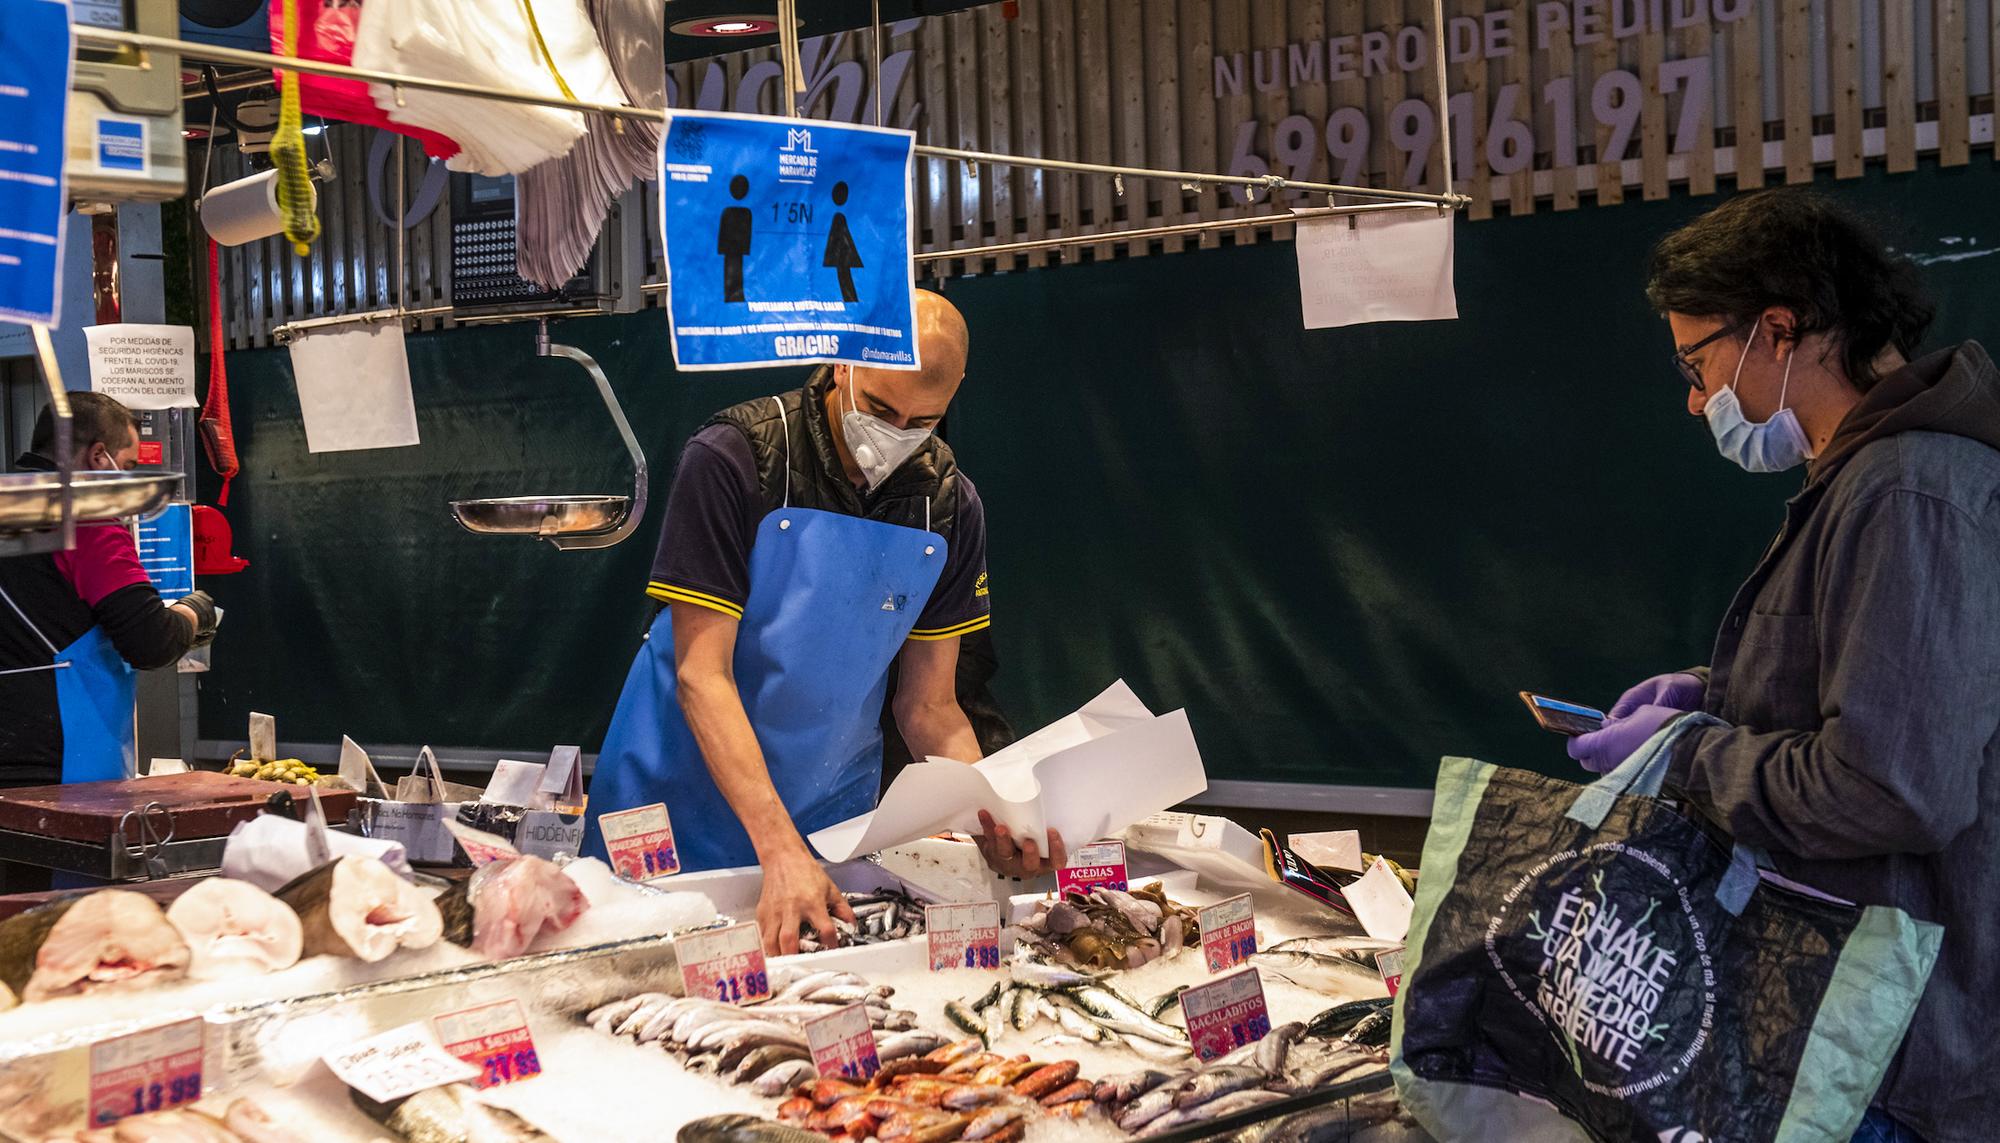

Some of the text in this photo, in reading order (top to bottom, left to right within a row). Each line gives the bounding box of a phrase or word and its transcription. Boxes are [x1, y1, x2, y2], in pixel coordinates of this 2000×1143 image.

[1214, 26, 1427, 98] NUMERO
[1450, 10, 1515, 63] DE
[779, 154, 817, 167] MERCADO DE
[779, 165, 817, 178] MARAVILLAS
[98, 347, 184, 355] SEGURIDAD HIGIÉNICAS
[774, 334, 839, 357] GRACIAS
[108, 386, 141, 394] PETICIÓN
[142, 387, 155, 395] DEL
[1190, 814, 1206, 839] G
[1283, 849, 1300, 878] PULPO
[1529, 861, 1549, 877] una
[1549, 849, 1578, 865] mano
[1593, 840, 1625, 852] medio
[1626, 846, 1671, 880] ambiente.
[1070, 867, 1114, 879] ACEDIAS
[1688, 914, 1700, 930] un
[1700, 954, 1712, 967] de
[1584, 951, 1659, 1013] MANO
[1558, 967, 1650, 1041] MEDIO
[1705, 992, 1717, 1003] al
[1190, 997, 1263, 1031] BACALADITOS
[1702, 1003, 1715, 1028] medi
